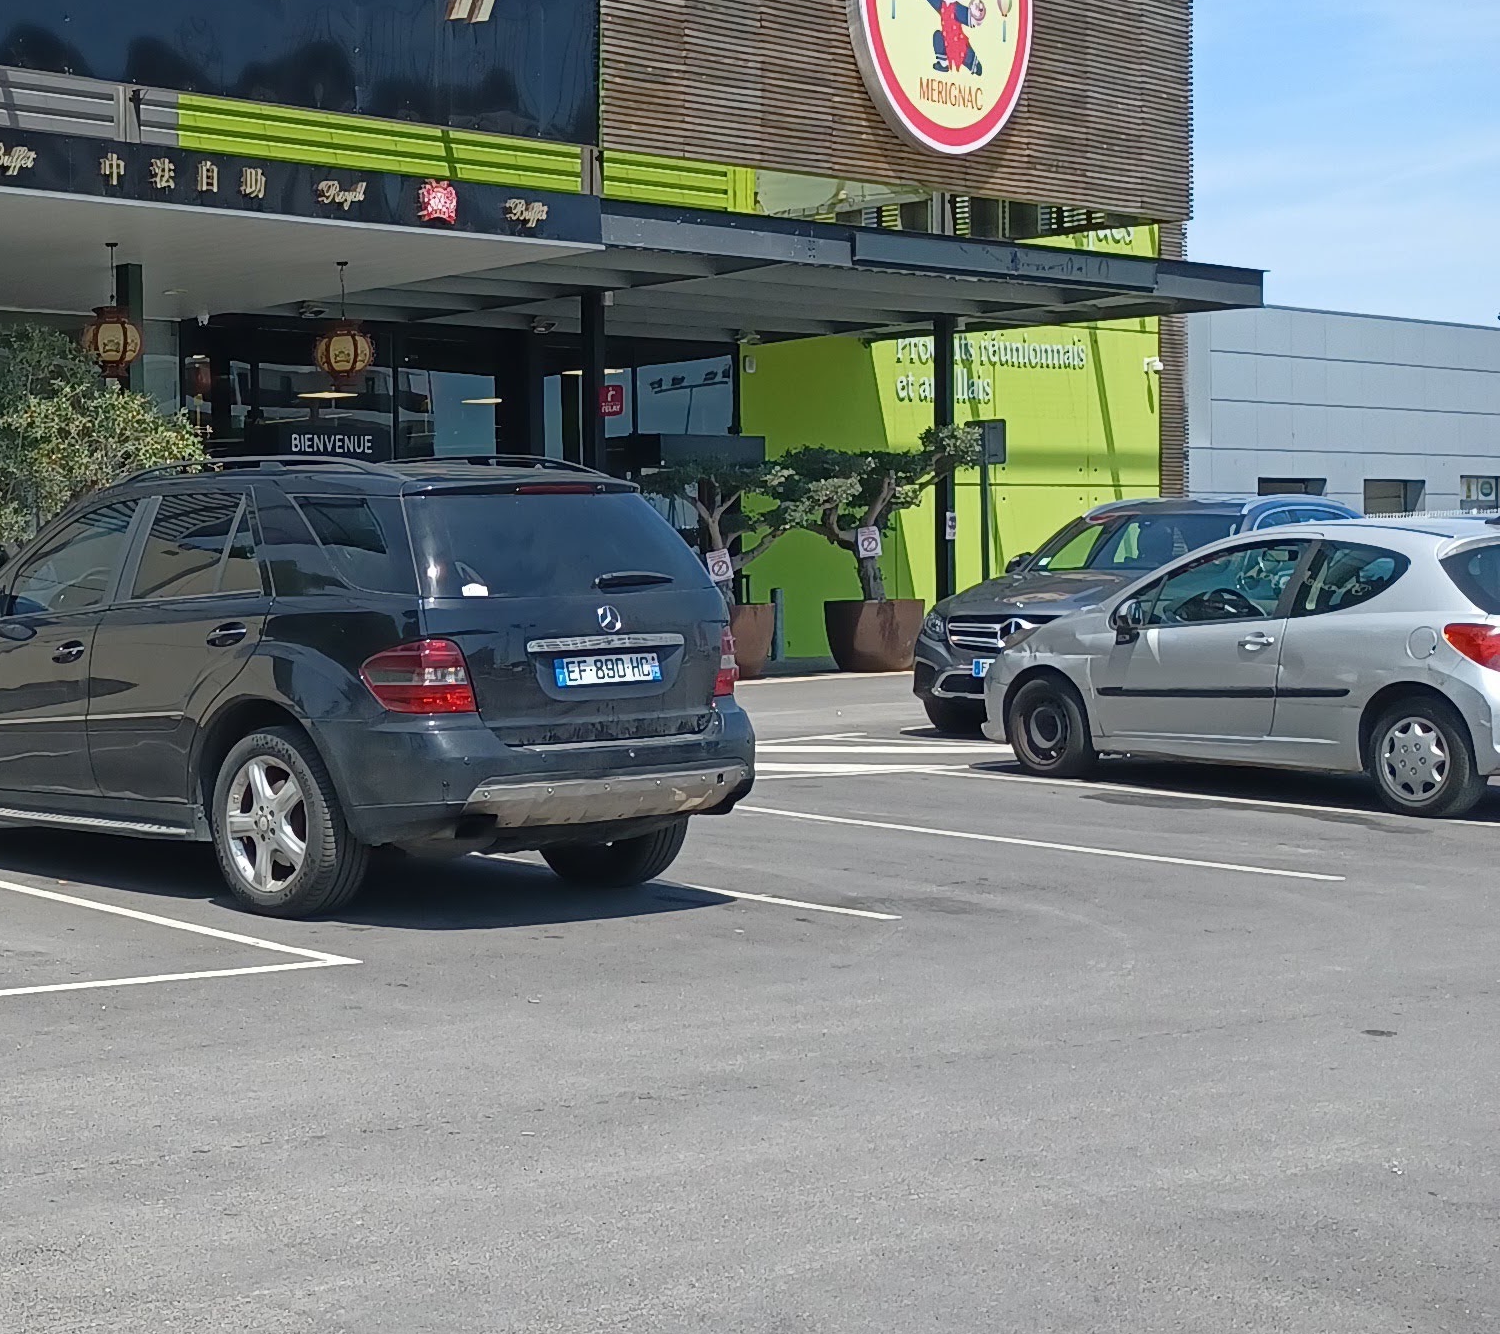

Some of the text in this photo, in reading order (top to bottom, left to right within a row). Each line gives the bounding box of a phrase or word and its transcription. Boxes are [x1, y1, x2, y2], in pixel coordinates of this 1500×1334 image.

[919, 76, 983, 111] MERIGNAC
[318, 180, 549, 228] Royal Buffet
[896, 333, 1086, 370] Proits réunionnais
[896, 371, 915, 402] et
[291, 433, 373, 454] BIENVENUE
